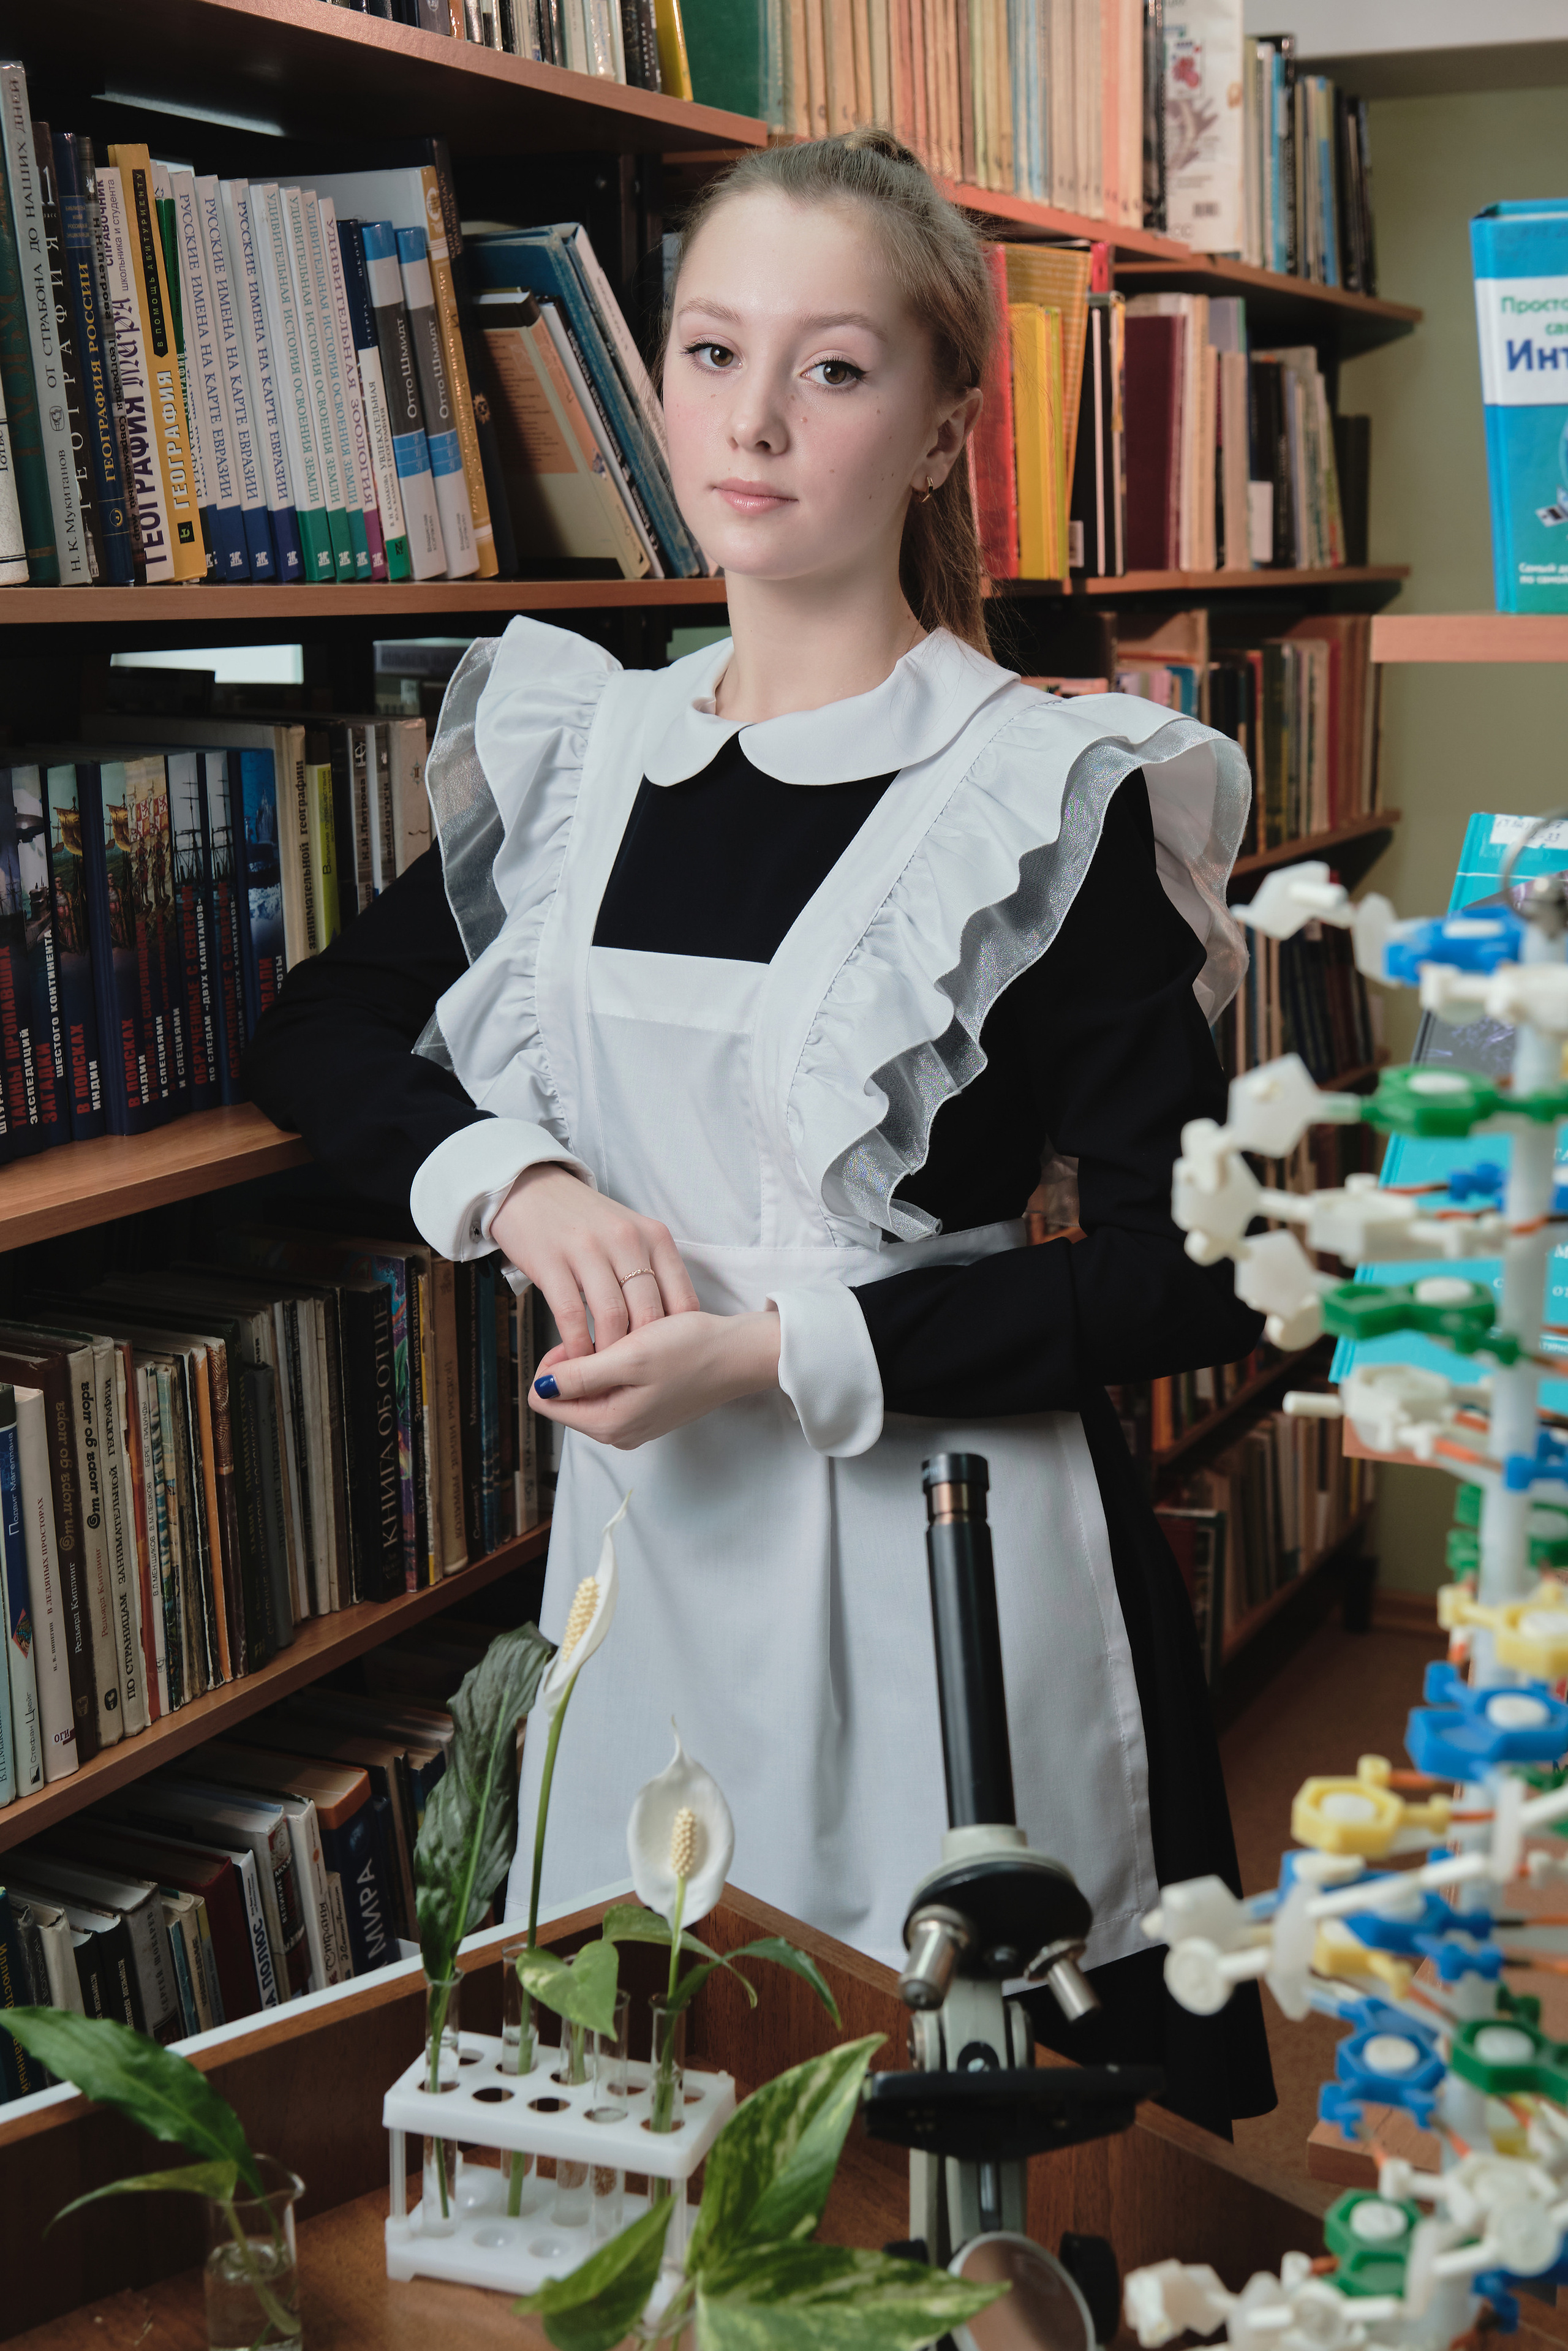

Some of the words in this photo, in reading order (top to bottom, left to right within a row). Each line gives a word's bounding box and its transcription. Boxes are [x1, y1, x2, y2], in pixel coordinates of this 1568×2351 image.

[10, 80, 26, 134] ДНЕЙ
[18, 142, 35, 217] НАШИХ
[108, 179, 121, 221] студента
[28, 227, 41, 253] ДО
[96, 179, 114, 267] СПРАВОЧНИК
[136, 173, 154, 270] АБИТУРИЕНТУ
[179, 193, 200, 270] РУССКИЕ
[204, 197, 225, 274] РУССКИЕ
[236, 200, 256, 276] РУССКИЕ
[115, 234, 129, 291] школьника
[34, 262, 53, 356] СТРАБОНА
[78, 263, 100, 353] РОССИИ
[149, 279, 162, 335] ПОМОЩЬ
[191, 274, 209, 339] ИМЕНА
[216, 278, 236, 342] ИМЕНА
[248, 279, 266, 343] ИМЕНА
[46, 236, 91, 510] ГЕОГРАФИЯ
[47, 364, 58, 388] ОТ
[200, 342, 214, 369] НА
[225, 344, 240, 371] НА
[257, 346, 271, 372] НА
[267, 192, 290, 304] УДИВИТЕЛЬНАЯ
[283, 308, 300, 375] ИСТОРИЯ
[293, 377, 312, 455] ОСВОЕНИЯ
[304, 456, 320, 504] ЗЕМЛИ
[289, 195, 312, 307] УДИВИТЕЛЬНАЯ
[305, 310, 322, 377] ИСТОРИЯ
[314, 379, 334, 455] ОСВОЕНИЯ
[326, 456, 341, 505] ЗЕМЛИ
[306, 201, 330, 310] УДИВИТЕЛЬНАЯ
[322, 314, 339, 379] ИСТОРИЯ
[332, 382, 351, 458] ОСВОЕНИЯ
[344, 458, 358, 505] ЗЕМЛИ
[326, 217, 356, 390] УДИВИТЕЛЬНАЯ
[350, 398, 373, 506] ЗООЛОГИЯ
[91, 358, 116, 482] ГЕОГРАФИЯ
[204, 371, 222, 424] КАРТЕ
[230, 374, 248, 426] КАРТЕ
[261, 376, 277, 427] КАРТЕ
[368, 380, 386, 470] УВЛЕКАТЕЛЬНАЯ
[108, 339, 123, 410] География
[119, 416, 135, 509] Современный
[132, 513, 141, 541] мир
[157, 371, 190, 509] ГЕОГРАФИЯ
[213, 428, 232, 500] ЕВРАЗИИ
[238, 429, 259, 501] ЕВРАЗИИ
[270, 431, 288, 502] ЕВРАЗИИ
[380, 407, 394, 469] ГЕОГРАФИЯ
[58, 450, 76, 530] Мукитанов
[124, 395, 167, 564] ГЕОГРАФИЯ
[383, 474, 393, 510] КАЗАКОВА
[296, 760, 308, 834] географии
[323, 832, 331, 875] Великие
[181, 886, 197, 960] СЕВЕРОМ
[218, 882, 232, 956] СЕВЕРОМ
[299, 841, 317, 950] занимательной
[196, 897, 208, 971] КАПИТАНОВ»
[44, 929, 59, 1013] КОНТИНЕНТА
[135, 921, 153, 1019] СОКРОВИЩАМИ
[187, 965, 198, 976] С
[201, 975, 211, 1011] «ДВУХ
[223, 960, 233, 971] С
[0, 946, 20, 1060] ПРОПАВШИХ
[144, 1022, 153, 1039] ЗА
[187, 980, 208, 1085] ОБРУЧЕННЫЕ
[224, 974, 240, 1079] ОБРУЧЕННЫЕ
[51, 1016, 64, 1078] ШЕСТОГО
[70, 1024, 89, 1098] ПОИСКАХ
[122, 1018, 139, 1092] ПОИСКАХ
[146, 1044, 157, 1089] ПОГОНЕ
[155, 1015, 167, 1087] СПЕЦИЯМИ
[173, 1007, 185, 1077] СПЕЦИЯМИ
[204, 1015, 214, 1065] СЛЕДАМ
[7, 1065, 27, 1129] ТАЙНЫ
[19, 1027, 39, 1125] ЭКСПЕДИЦИЙ
[36, 1043, 58, 1123] ЗАГАДКИ
[89, 1060, 102, 1111] ИНДИИ
[128, 1096, 140, 1108] В
[138, 1054, 149, 1104] ИНДИИ
[162, 1089, 168, 1098] И
[179, 1080, 186, 1089] И
[209, 1067, 216, 1082] ПО
[77, 1103, 91, 1114] В
[373, 1297, 392, 1387] ОТЦЕ
[410, 1267, 422, 1371] неразгаданная
[81, 1381, 94, 1424] моря
[105, 1378, 116, 1456] ГЕОГРАФИИ
[377, 1392, 394, 1436] ОБ
[413, 1373, 423, 1422] Земля
[445, 1359, 456, 1421] РУССКОЙ
[56, 1400, 70, 1446] моря
[85, 1427, 97, 1447] до
[270, 1409, 282, 1491] ПАСЕНЮК
[449, 1425, 459, 1470] ЗЕМЛИ
[9, 1431, 17, 1493] Магеллана
[60, 1448, 73, 1468] до
[86, 1451, 99, 1495] моря
[9, 1502, 20, 1536] Подвиг
[61, 1472, 75, 1517] моря
[109, 1464, 126, 1585] ЗАНИМАТЕЛЬНОЙ
[276, 1497, 286, 1552] ЛЕОНИД
[380, 1440, 398, 1549] КНИГА
[37, 1496, 47, 1556] ПРОСТОРАХ
[42, 1558, 52, 1606] ЛЕДЯНЫХ
[70, 1562, 79, 1611] Киплинг
[96, 1548, 105, 1595] Киплинг
[70, 1612, 83, 1654] Редьярд
[99, 1596, 108, 1637] Редьярд
[120, 1593, 134, 1675] СТРАНИЦАМ
[24, 1692, 36, 1724] Цвейг
[127, 1679, 136, 1701] ПО
[275, 1875, 288, 1923] ВЕЛИКИЕ
[357, 1858, 386, 1960] МИРА
[146, 1911, 163, 1969] ШОКАРЕВ
[253, 1918, 273, 1990] ПОЛЮС
[319, 1902, 336, 1972] Страны
[118, 1958, 129, 1997] Историческое
[155, 1969, 168, 2012] СЕРГЕЙ
[192, 1936, 206, 2007] КРАЕВЕДЕНИЕ
